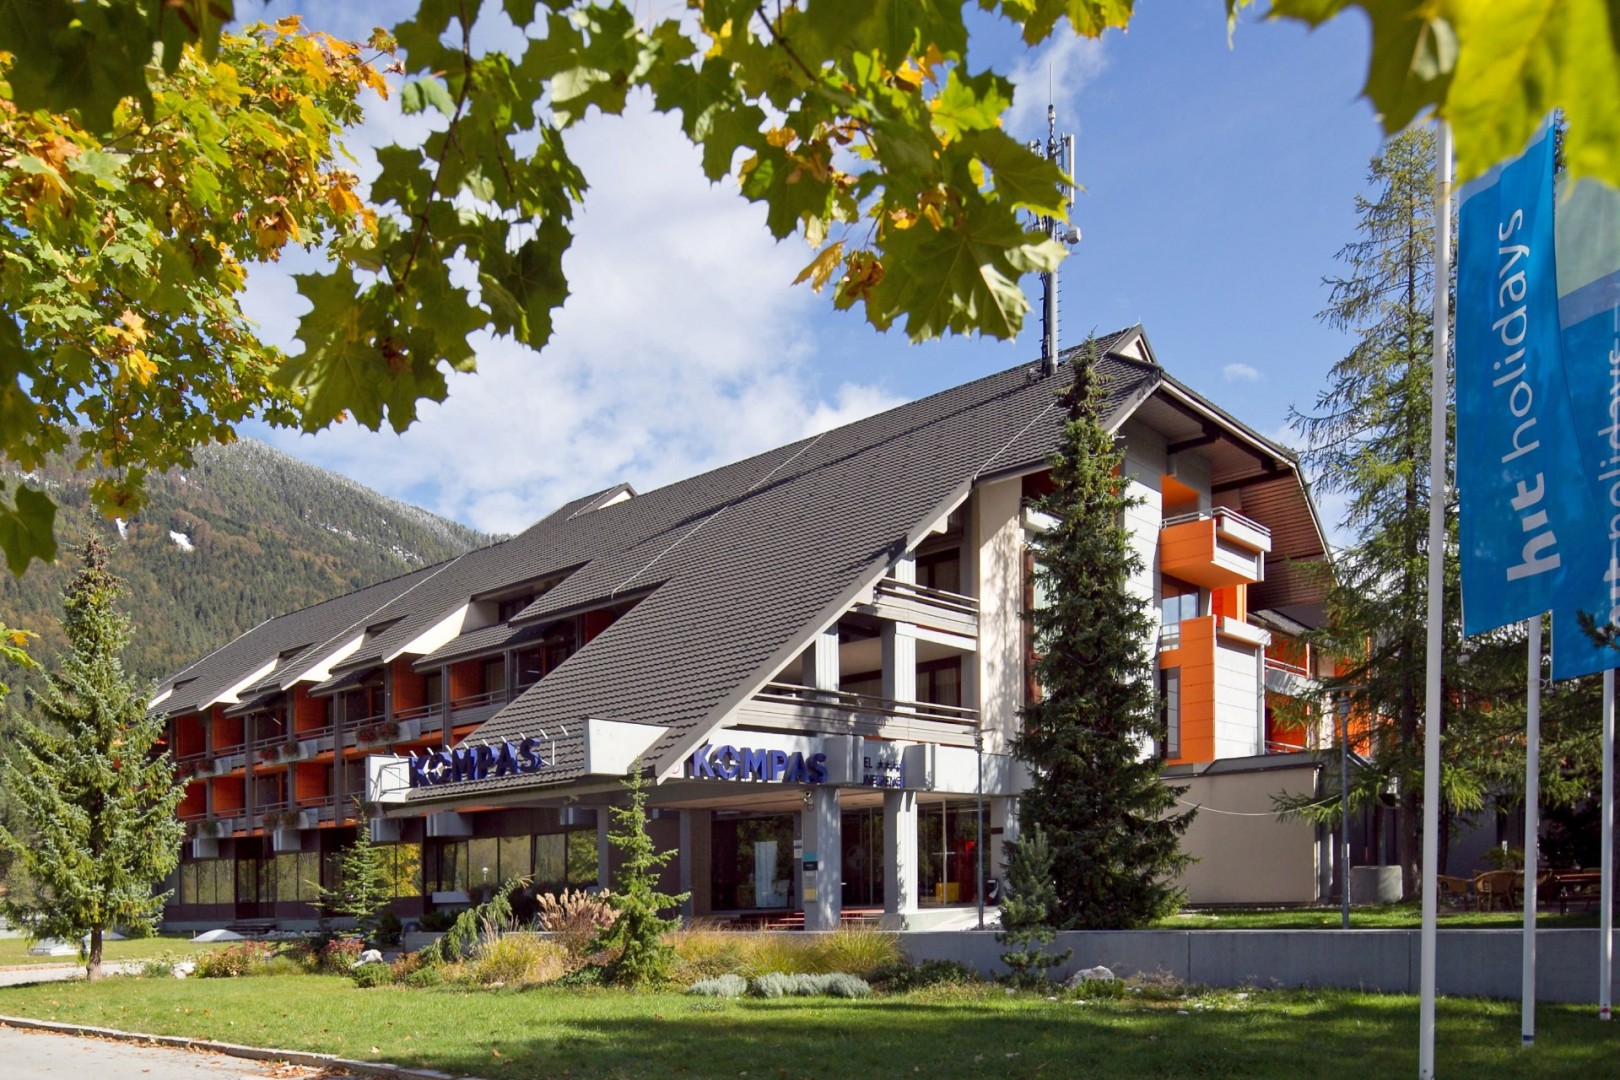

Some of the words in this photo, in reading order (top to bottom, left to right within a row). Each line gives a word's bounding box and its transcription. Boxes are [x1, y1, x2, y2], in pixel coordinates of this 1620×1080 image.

[1492, 208, 1540, 464] holidays
[1506, 471, 1561, 582] hit
[408, 737, 543, 788] KOMPAS
[690, 743, 829, 785] KOMPAS
